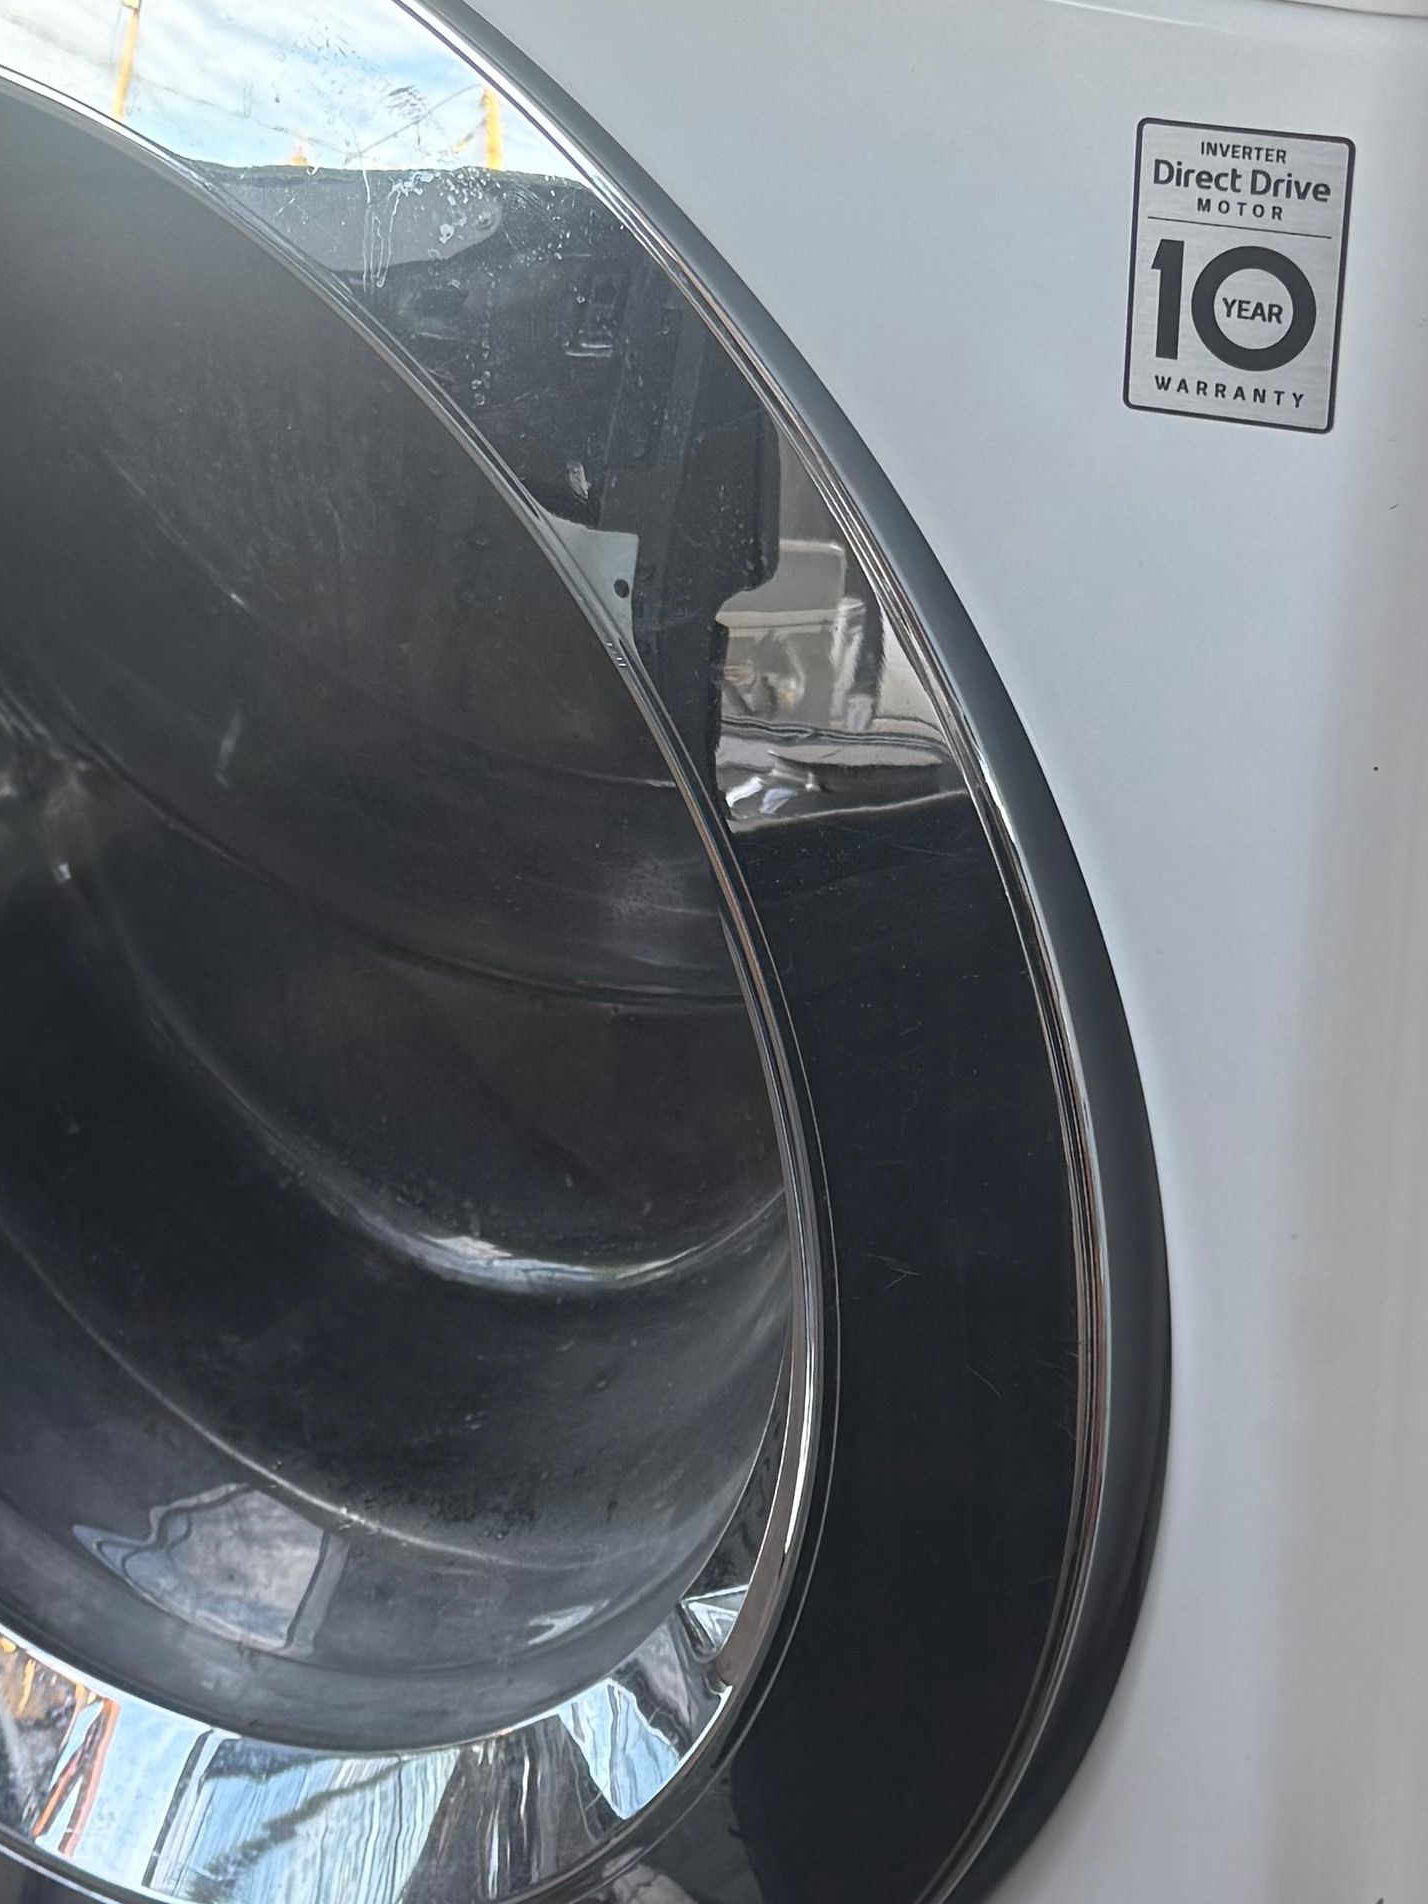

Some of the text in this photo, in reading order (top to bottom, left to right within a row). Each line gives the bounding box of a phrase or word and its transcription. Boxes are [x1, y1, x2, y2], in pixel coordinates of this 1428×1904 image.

[1200, 141, 1287, 164] INVERTER
[1153, 158, 1332, 203] Direct Drive
[1196, 198, 1284, 221] MOTOR
[1150, 238, 1317, 372] 10
[1222, 297, 1284, 325] YEAR
[1154, 375, 1304, 409] WARRANTY
